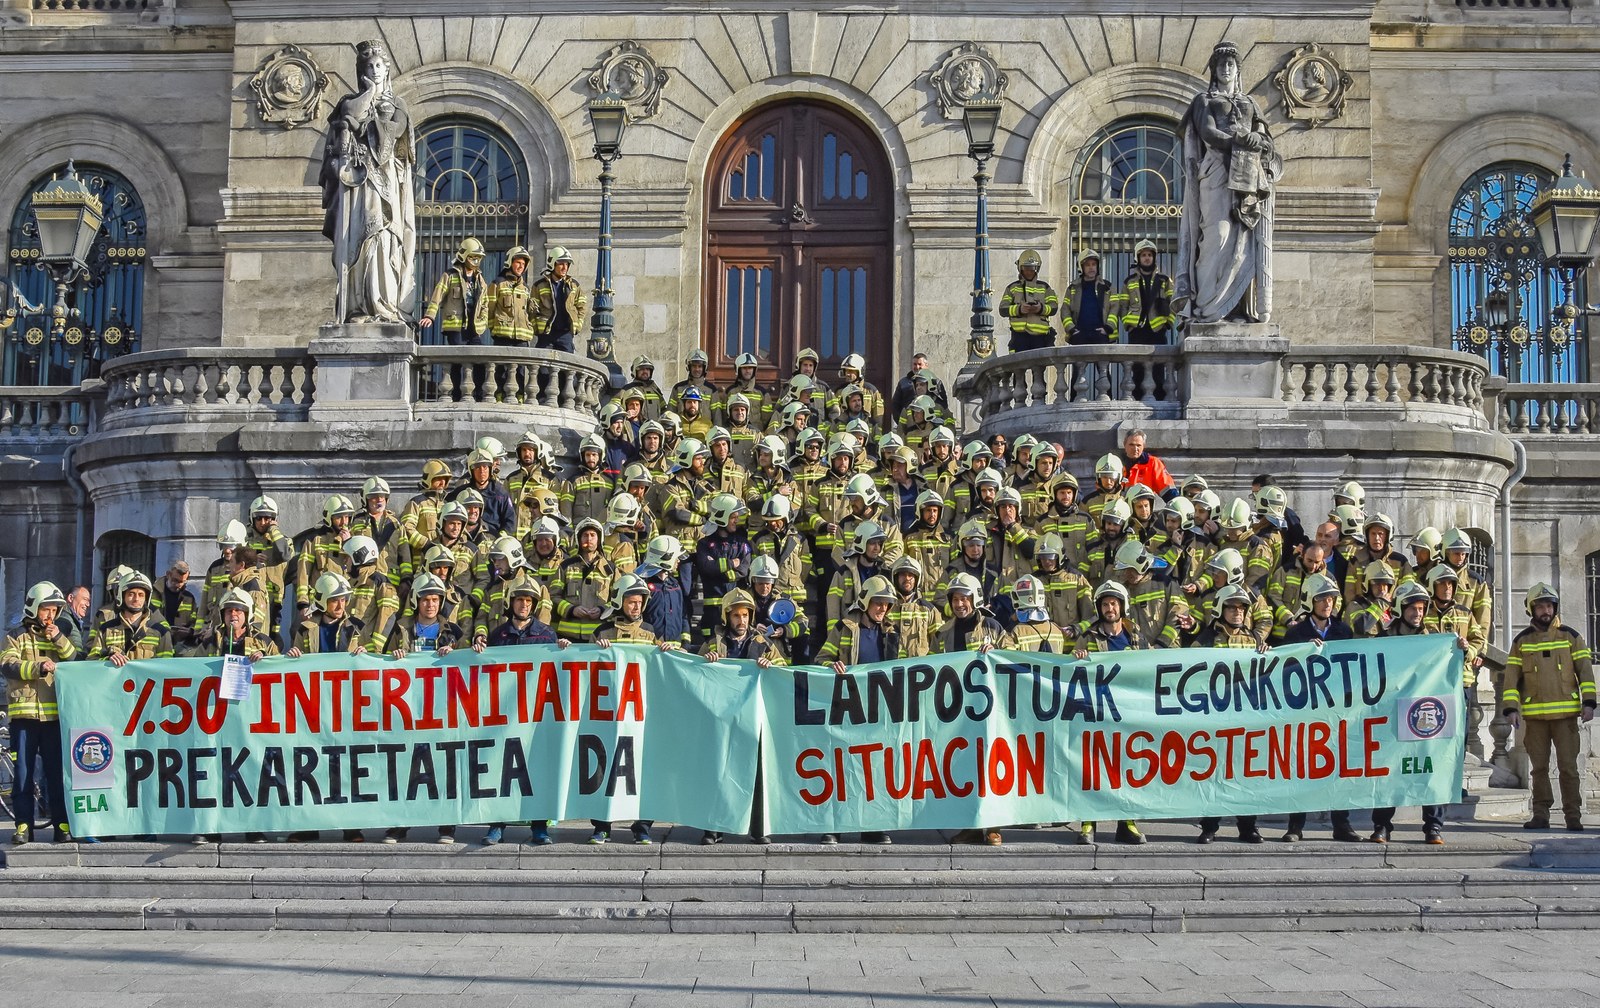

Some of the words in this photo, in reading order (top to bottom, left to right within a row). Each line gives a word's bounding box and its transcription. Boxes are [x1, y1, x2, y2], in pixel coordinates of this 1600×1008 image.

[123, 676, 228, 736] %50
[249, 661, 645, 734] INTERINITATEA
[793, 659, 1122, 726] LANPOSTUAK
[1154, 652, 1387, 716] EGONKORTU
[125, 737, 534, 809] PREKARIETATEA
[578, 734, 637, 797] DA
[795, 731, 1045, 806] SITUACION
[1081, 716, 1390, 791] INSOSTENIBLE
[1401, 756, 1434, 775] ELA
[74, 794, 109, 814] ELA
